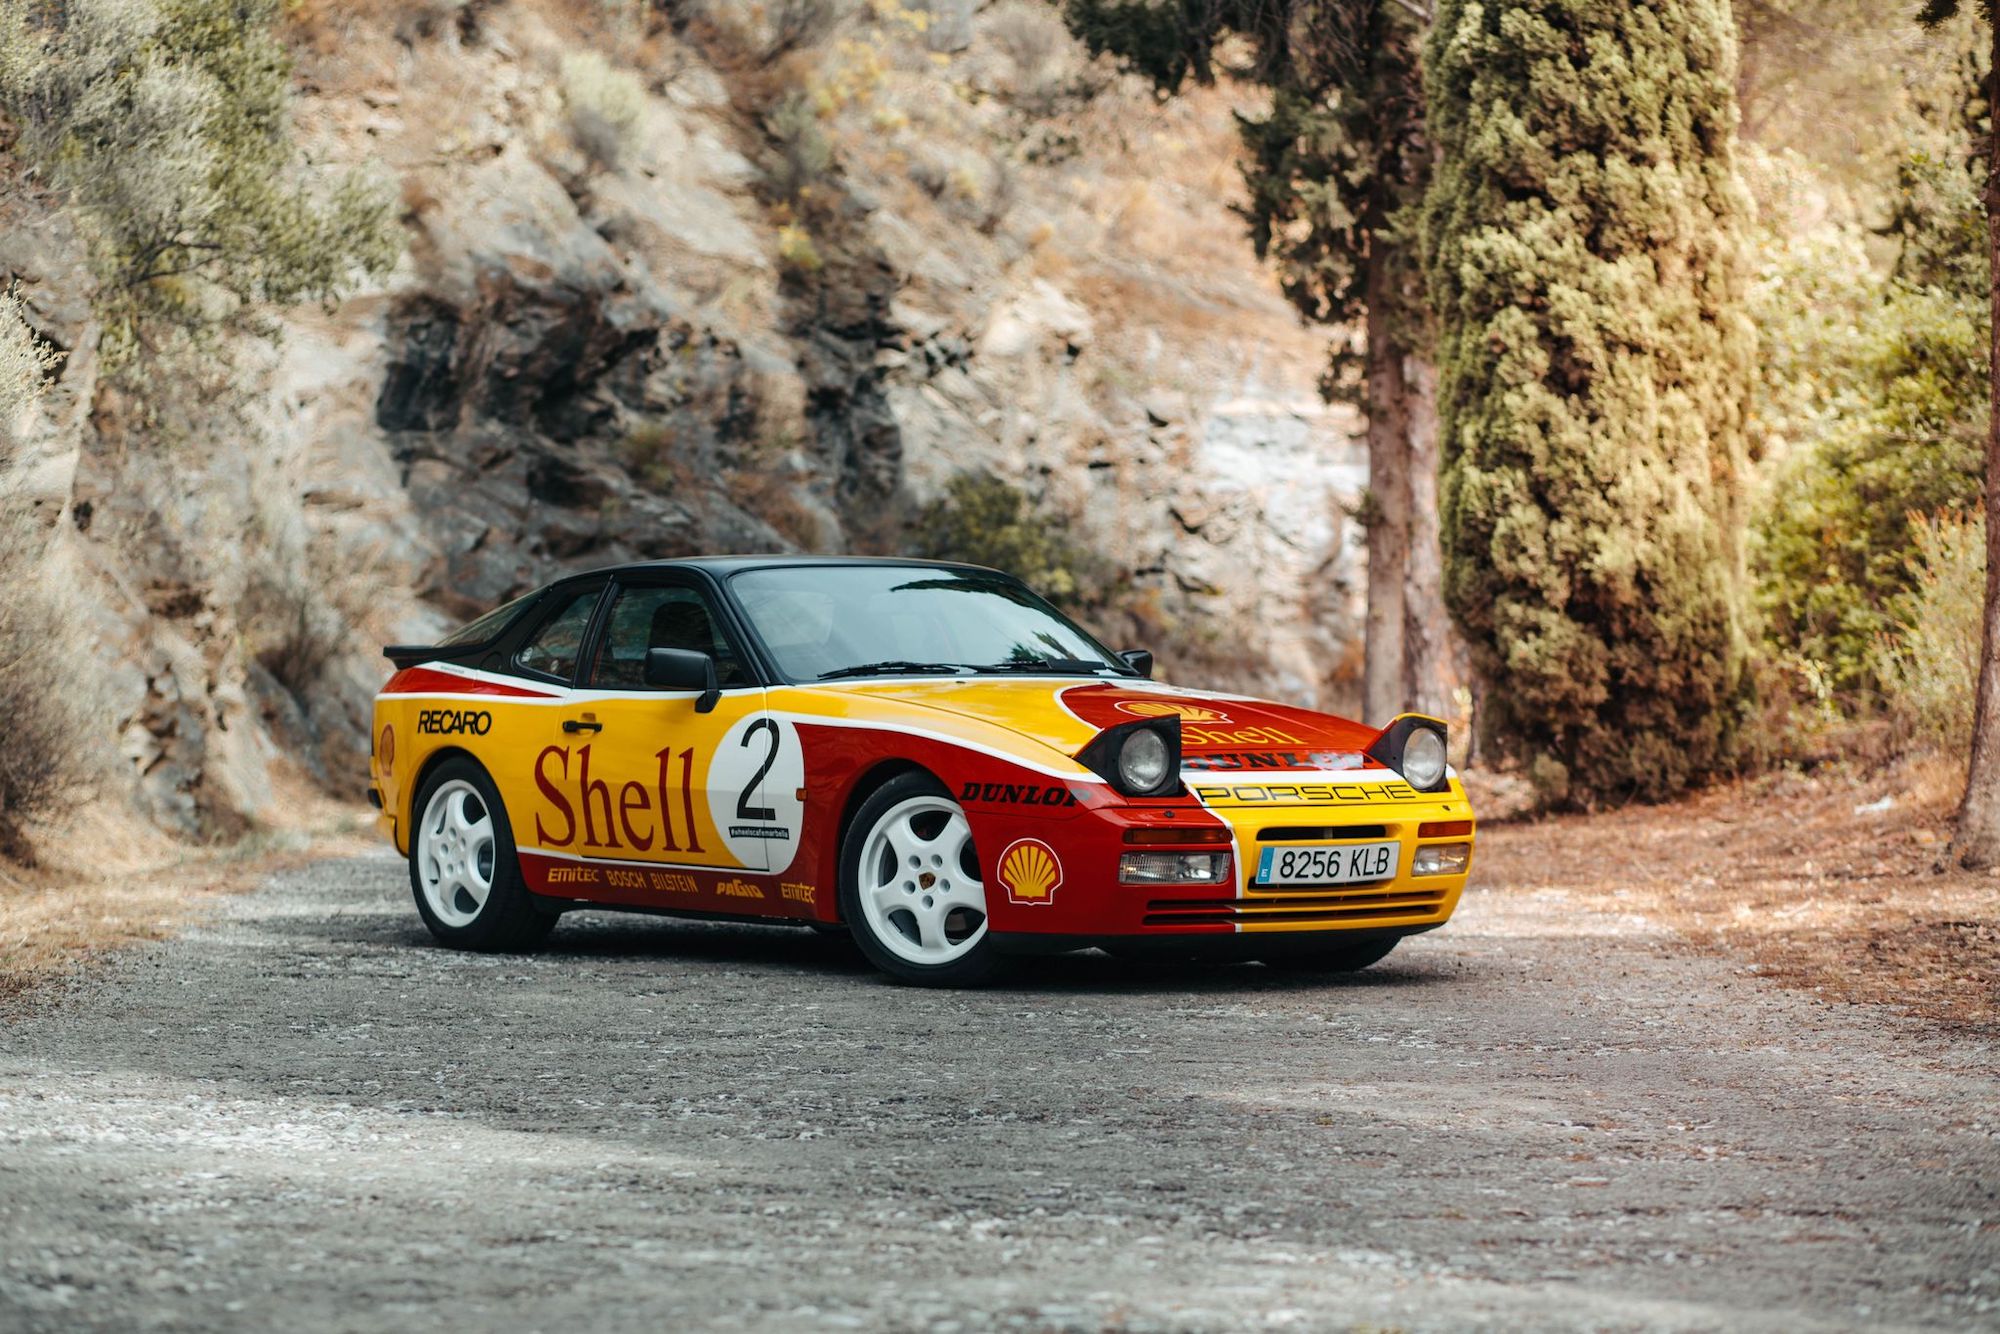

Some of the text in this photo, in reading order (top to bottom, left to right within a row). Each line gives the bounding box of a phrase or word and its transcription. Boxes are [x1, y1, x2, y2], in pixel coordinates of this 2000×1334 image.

[417, 710, 492, 736] RECARO
[736, 718, 780, 820] 2
[534, 744, 706, 853] Shell
[1197, 784, 1416, 802] PORSCHE
[1260, 847, 1390, 879] E 8256 KLB
[606, 870, 647, 888] BOSCH
[650, 873, 699, 893] BILSTEIN
